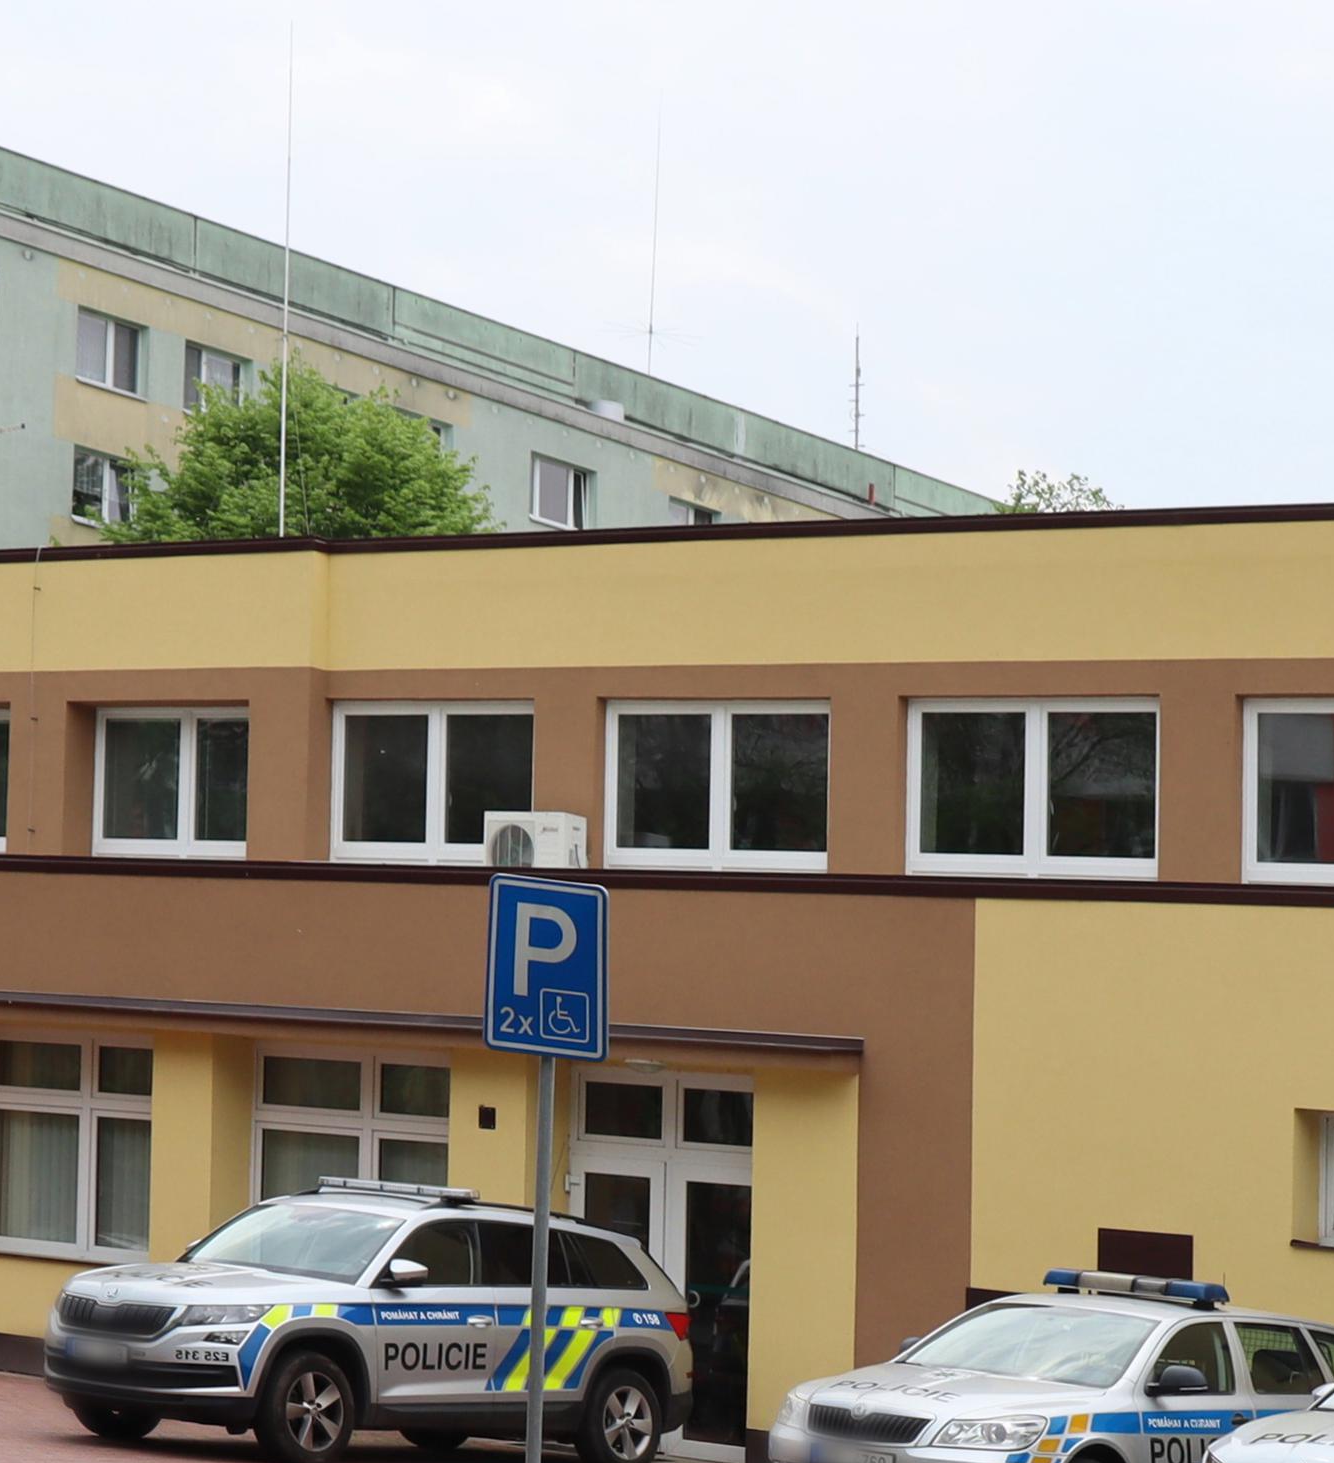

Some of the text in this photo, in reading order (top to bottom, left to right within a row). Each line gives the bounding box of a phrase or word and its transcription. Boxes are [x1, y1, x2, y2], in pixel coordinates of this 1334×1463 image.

[513, 902, 577, 997] P
[500, 1006, 534, 1036] 2x
[419, 1311, 427, 1320] A
[642, 1313, 661, 1326] 158
[384, 1343, 487, 1371] POLICIE
[830, 1380, 961, 1403] POLICIE
